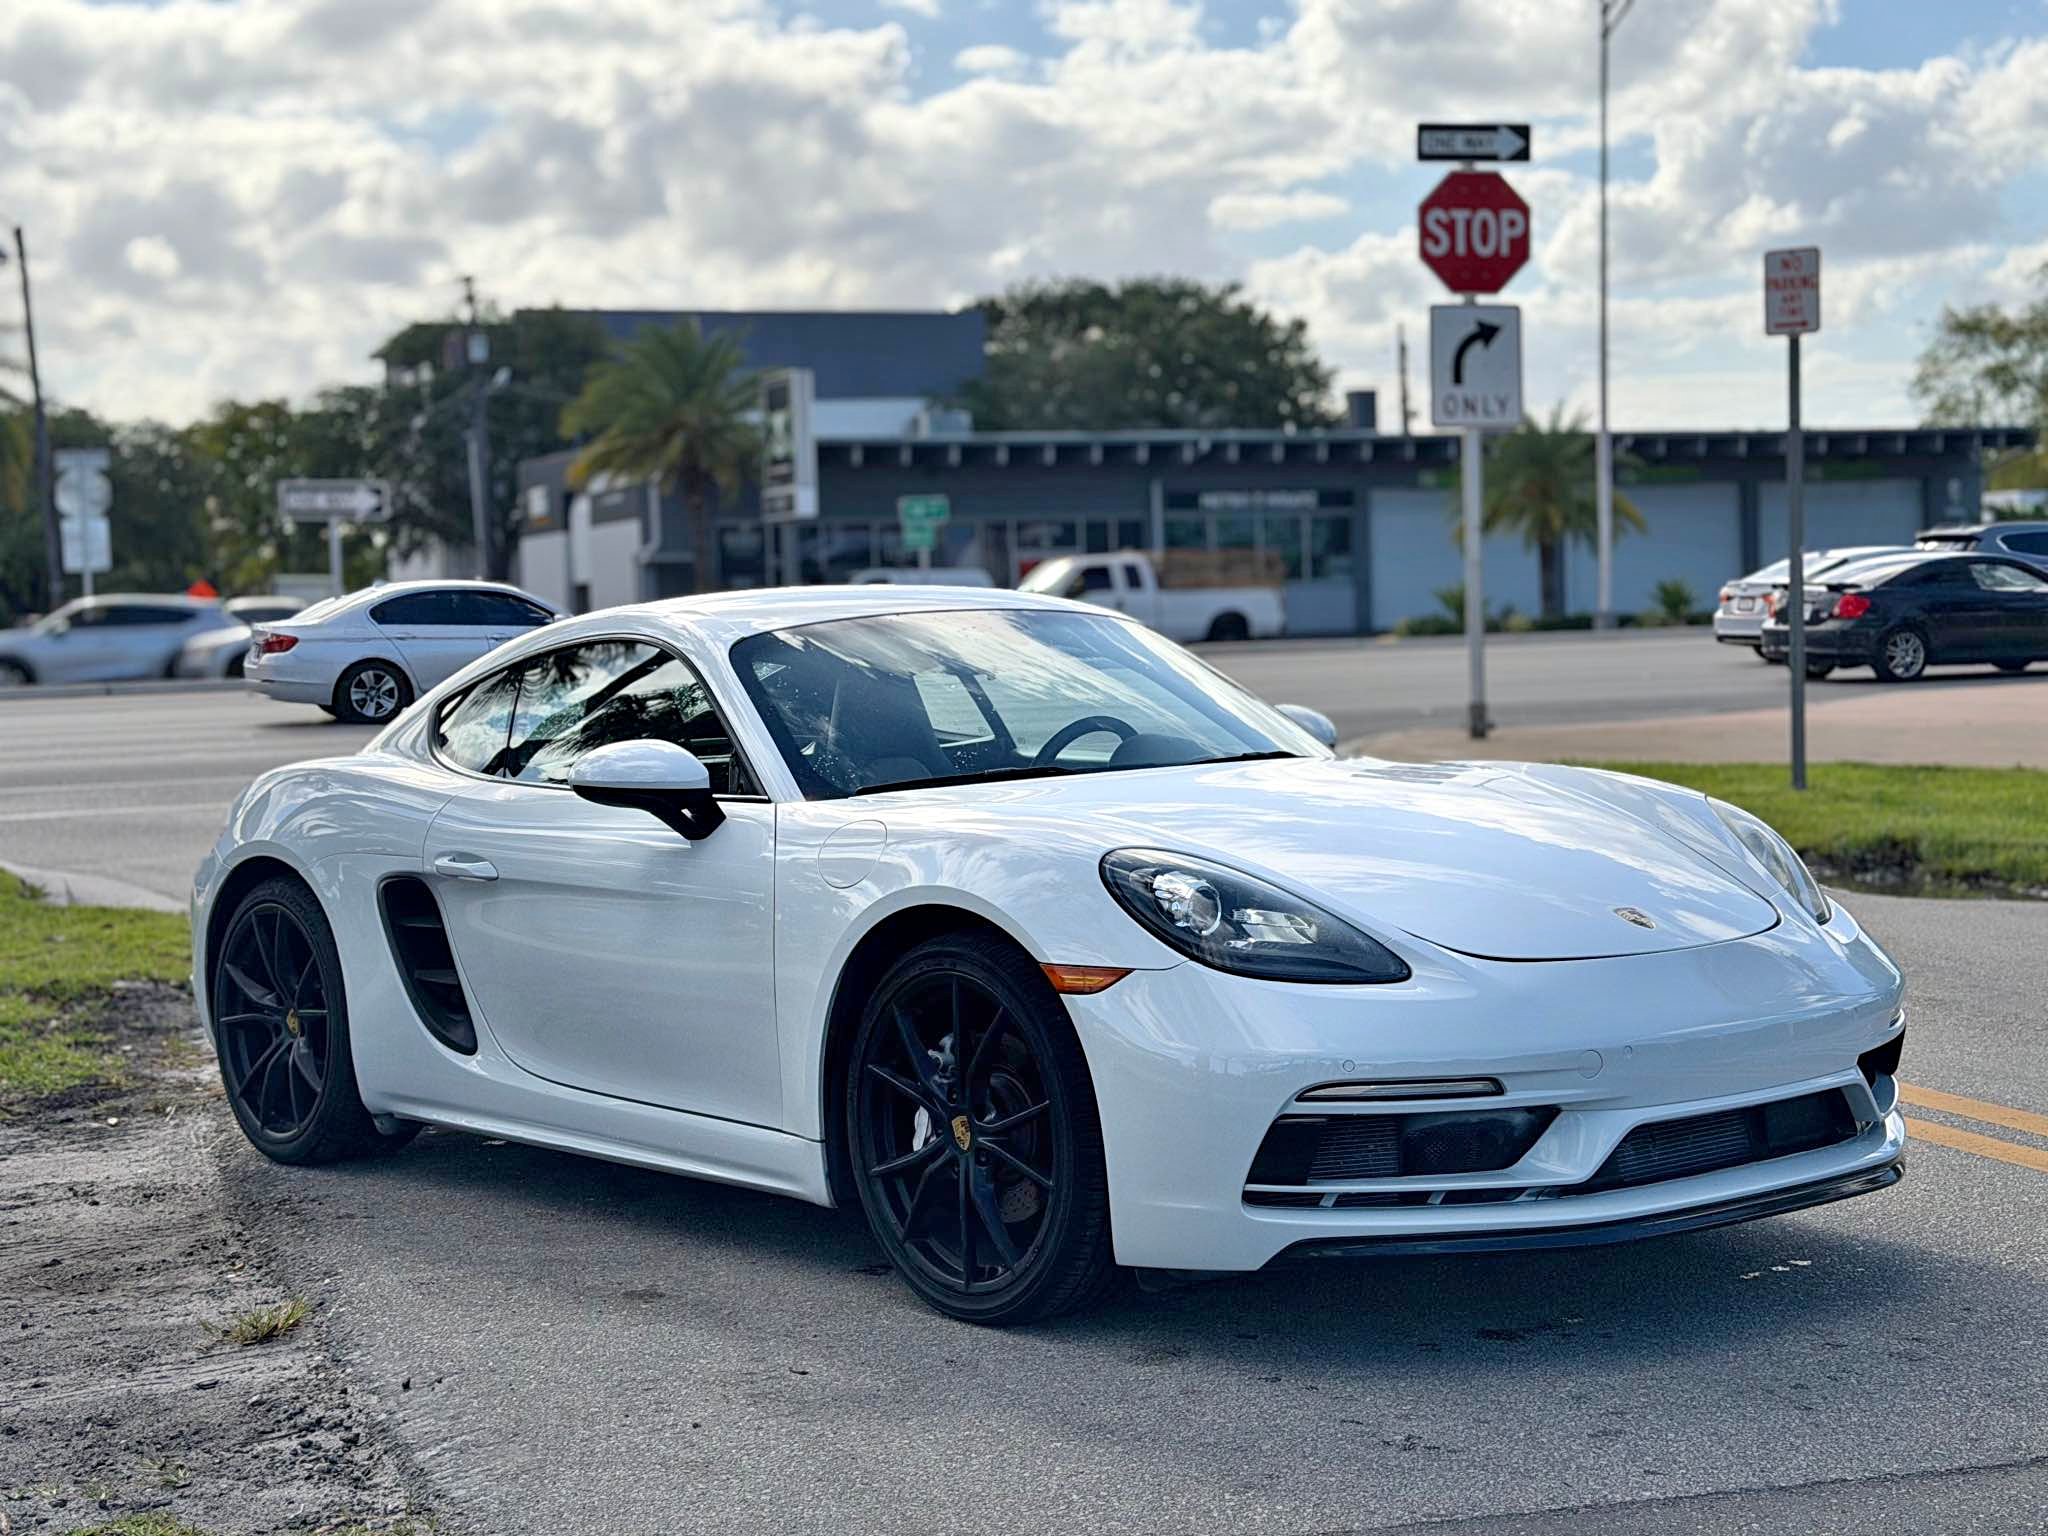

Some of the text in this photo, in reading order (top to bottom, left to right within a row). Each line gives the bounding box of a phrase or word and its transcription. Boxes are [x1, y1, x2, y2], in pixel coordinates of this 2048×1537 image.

[1424, 207, 1526, 257] STOP
[1781, 255, 1803, 272] NO
[1767, 275, 1817, 290] PARKING
[1442, 393, 1510, 418] ONLY
